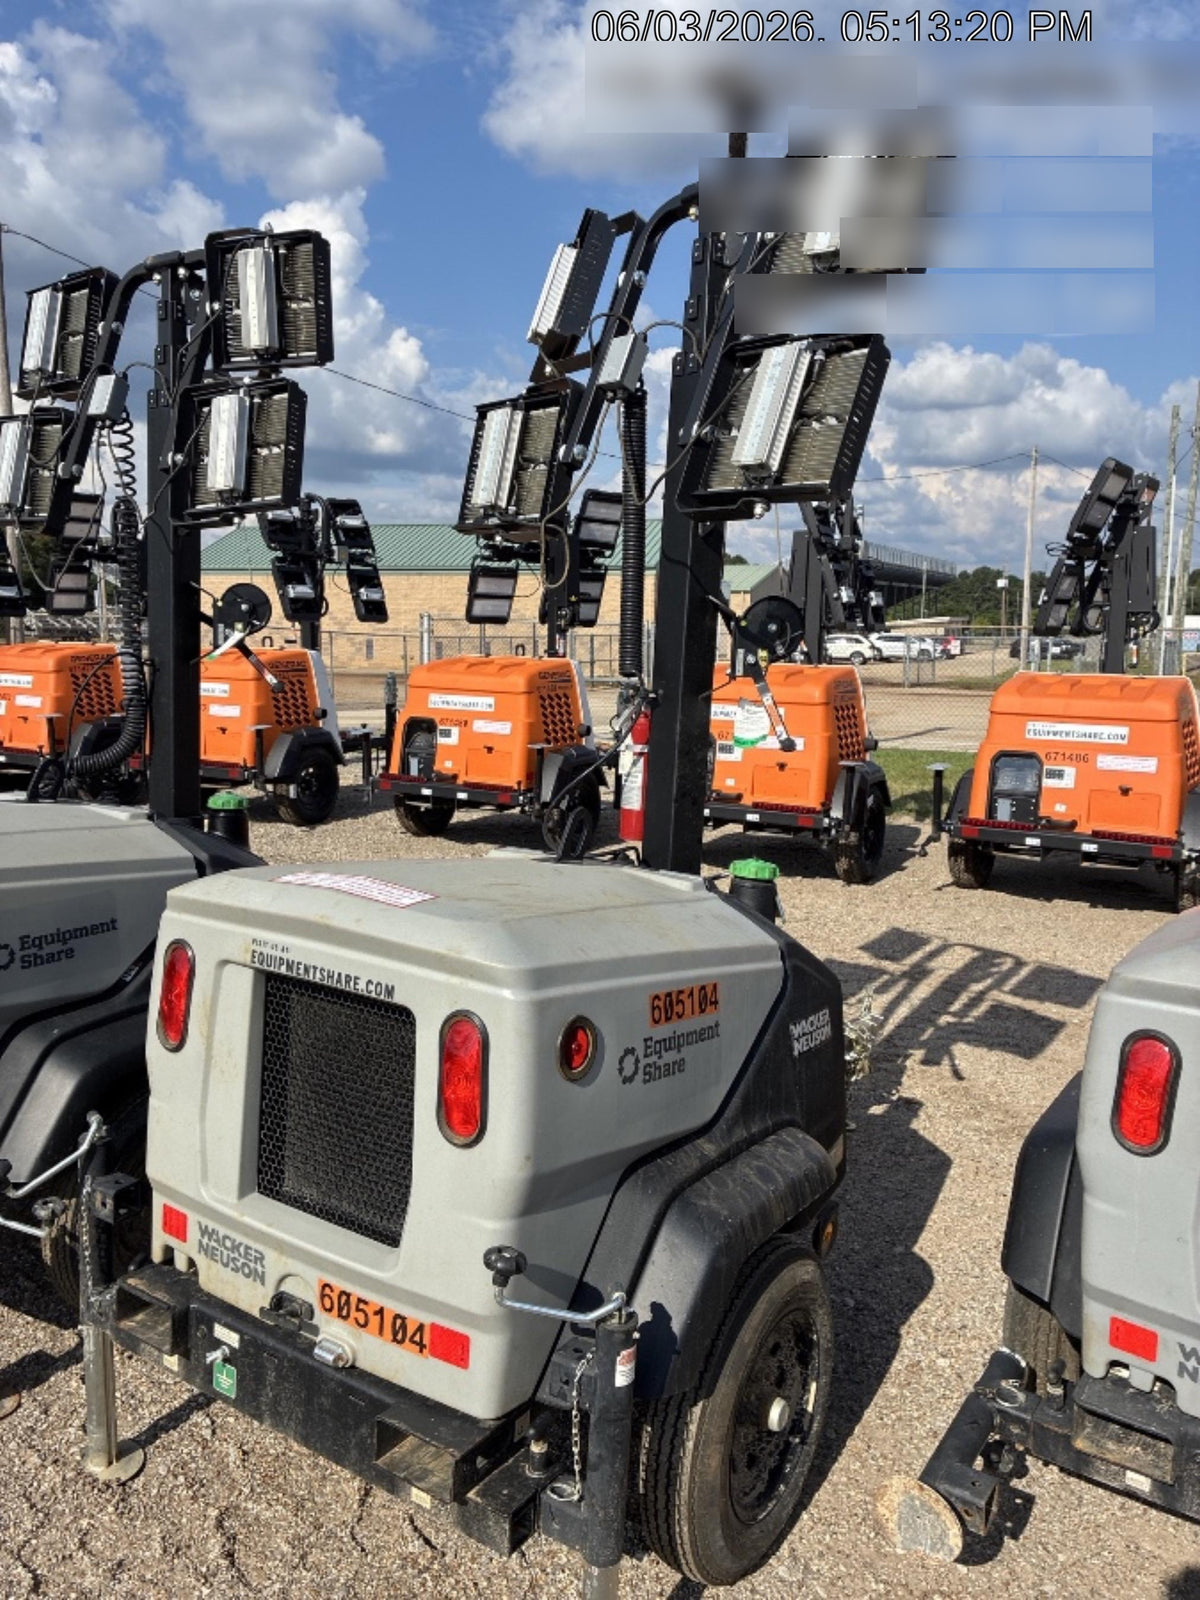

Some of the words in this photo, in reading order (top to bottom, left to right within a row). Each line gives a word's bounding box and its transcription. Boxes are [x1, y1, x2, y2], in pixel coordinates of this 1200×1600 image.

[19, 917, 118, 951] Equipment
[20, 947, 75, 970] Share
[251, 949, 396, 1000] EQUIPMENTSHARE.COM
[651, 982, 719, 1025] 605104
[789, 1008, 830, 1038] WACKER
[643, 1020, 720, 1059] Equipment
[793, 1022, 832, 1057] NEUSON
[642, 1057, 686, 1084] Share
[198, 1221, 265, 1268] WACKER
[198, 1239, 265, 1287] NEUSON
[320, 1283, 427, 1354] 605104
